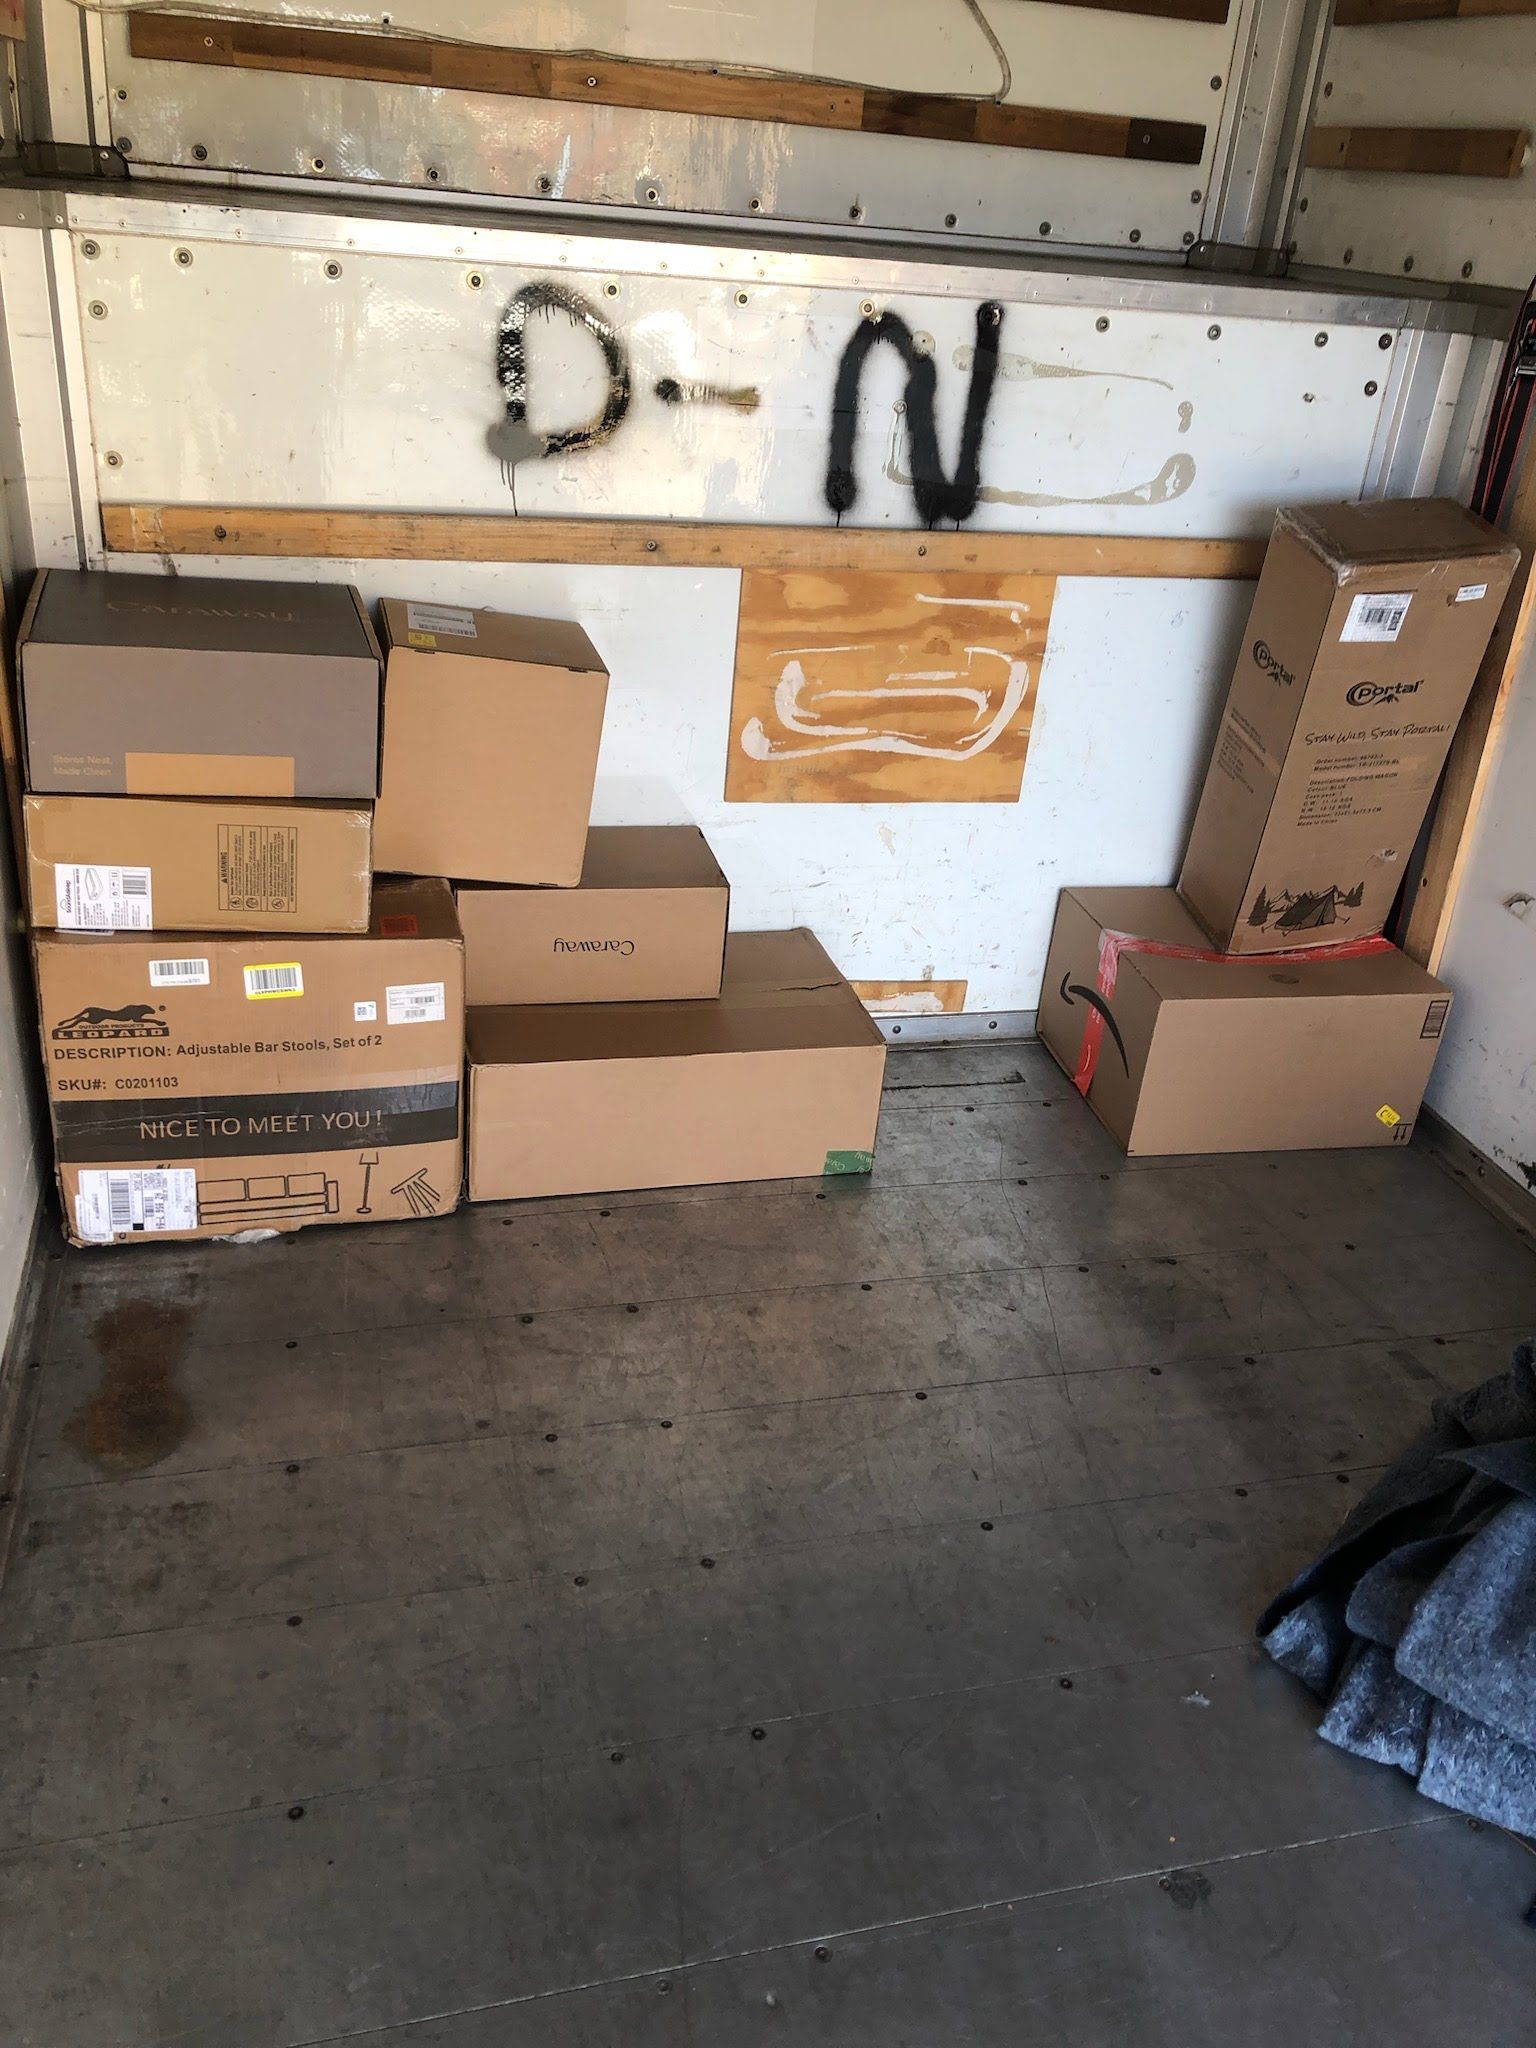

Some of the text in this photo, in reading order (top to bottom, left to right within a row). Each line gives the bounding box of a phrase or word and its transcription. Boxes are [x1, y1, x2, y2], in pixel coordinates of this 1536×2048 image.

[553, 937, 635, 956] Caraway
[57, 1028, 164, 1040] LEOPARD
[54, 1035, 382, 1060] DESCRIPTION: Adjustable Bar Stools, Set of 2
[58, 1077, 179, 1091] SKU#: C0201103
[140, 1119, 199, 1139] NICE
[205, 1117, 241, 1136] TO
[249, 1114, 314, 1134] MEET
